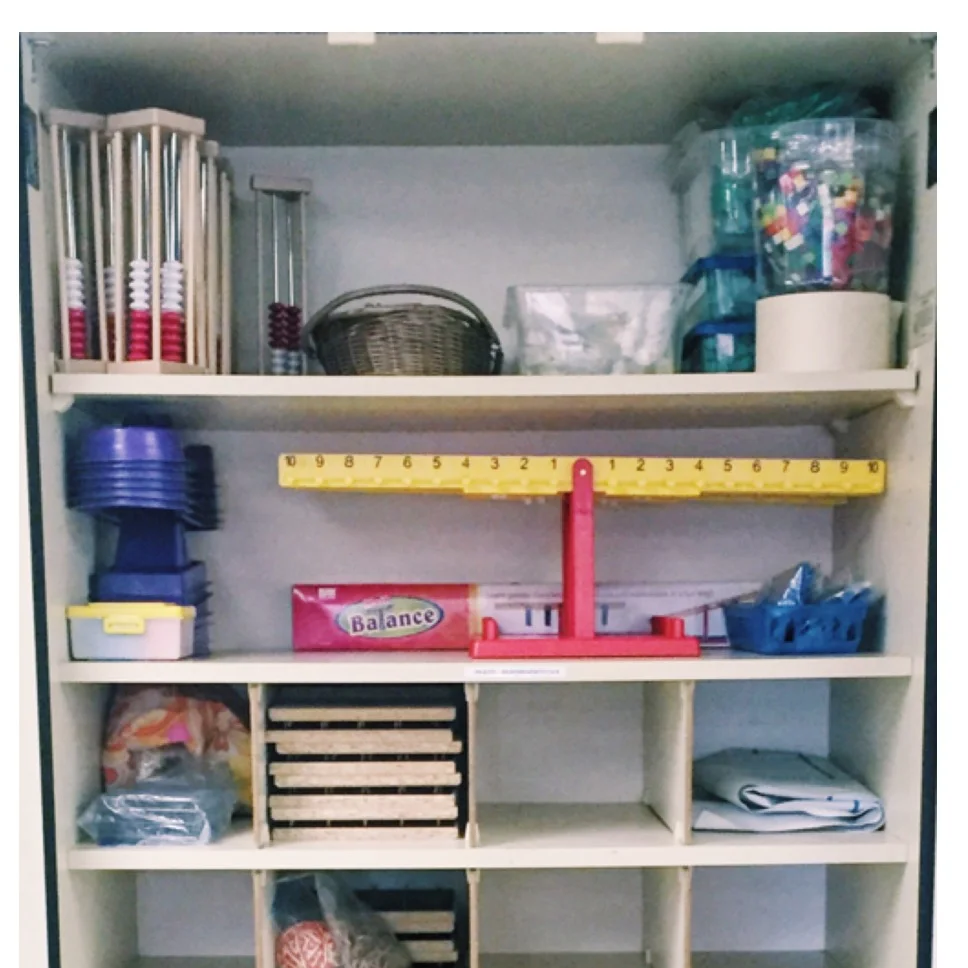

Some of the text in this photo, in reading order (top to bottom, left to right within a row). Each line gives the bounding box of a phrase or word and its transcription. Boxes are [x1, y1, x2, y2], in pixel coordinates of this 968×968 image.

[315, 455, 325, 468] 9
[344, 455, 354, 468] 8
[374, 455, 383, 468] 7
[403, 455, 412, 468] 6
[432, 456, 442, 469] 5
[461, 457, 470, 468] 4
[491, 458, 500, 470] 3
[519, 457, 529, 470] 2
[550, 458, 558, 470] 1
[609, 459, 616, 471] 1
[636, 459, 645, 471] 2
[665, 459, 674, 472] 3
[694, 459, 704, 471] 4
[723, 460, 733, 472] 5
[752, 460, 762, 473] 6
[782, 460, 791, 473] 7
[810, 460, 820, 473] 8
[839, 461, 849, 474] 9
[350, 604, 435, 633] Balance
